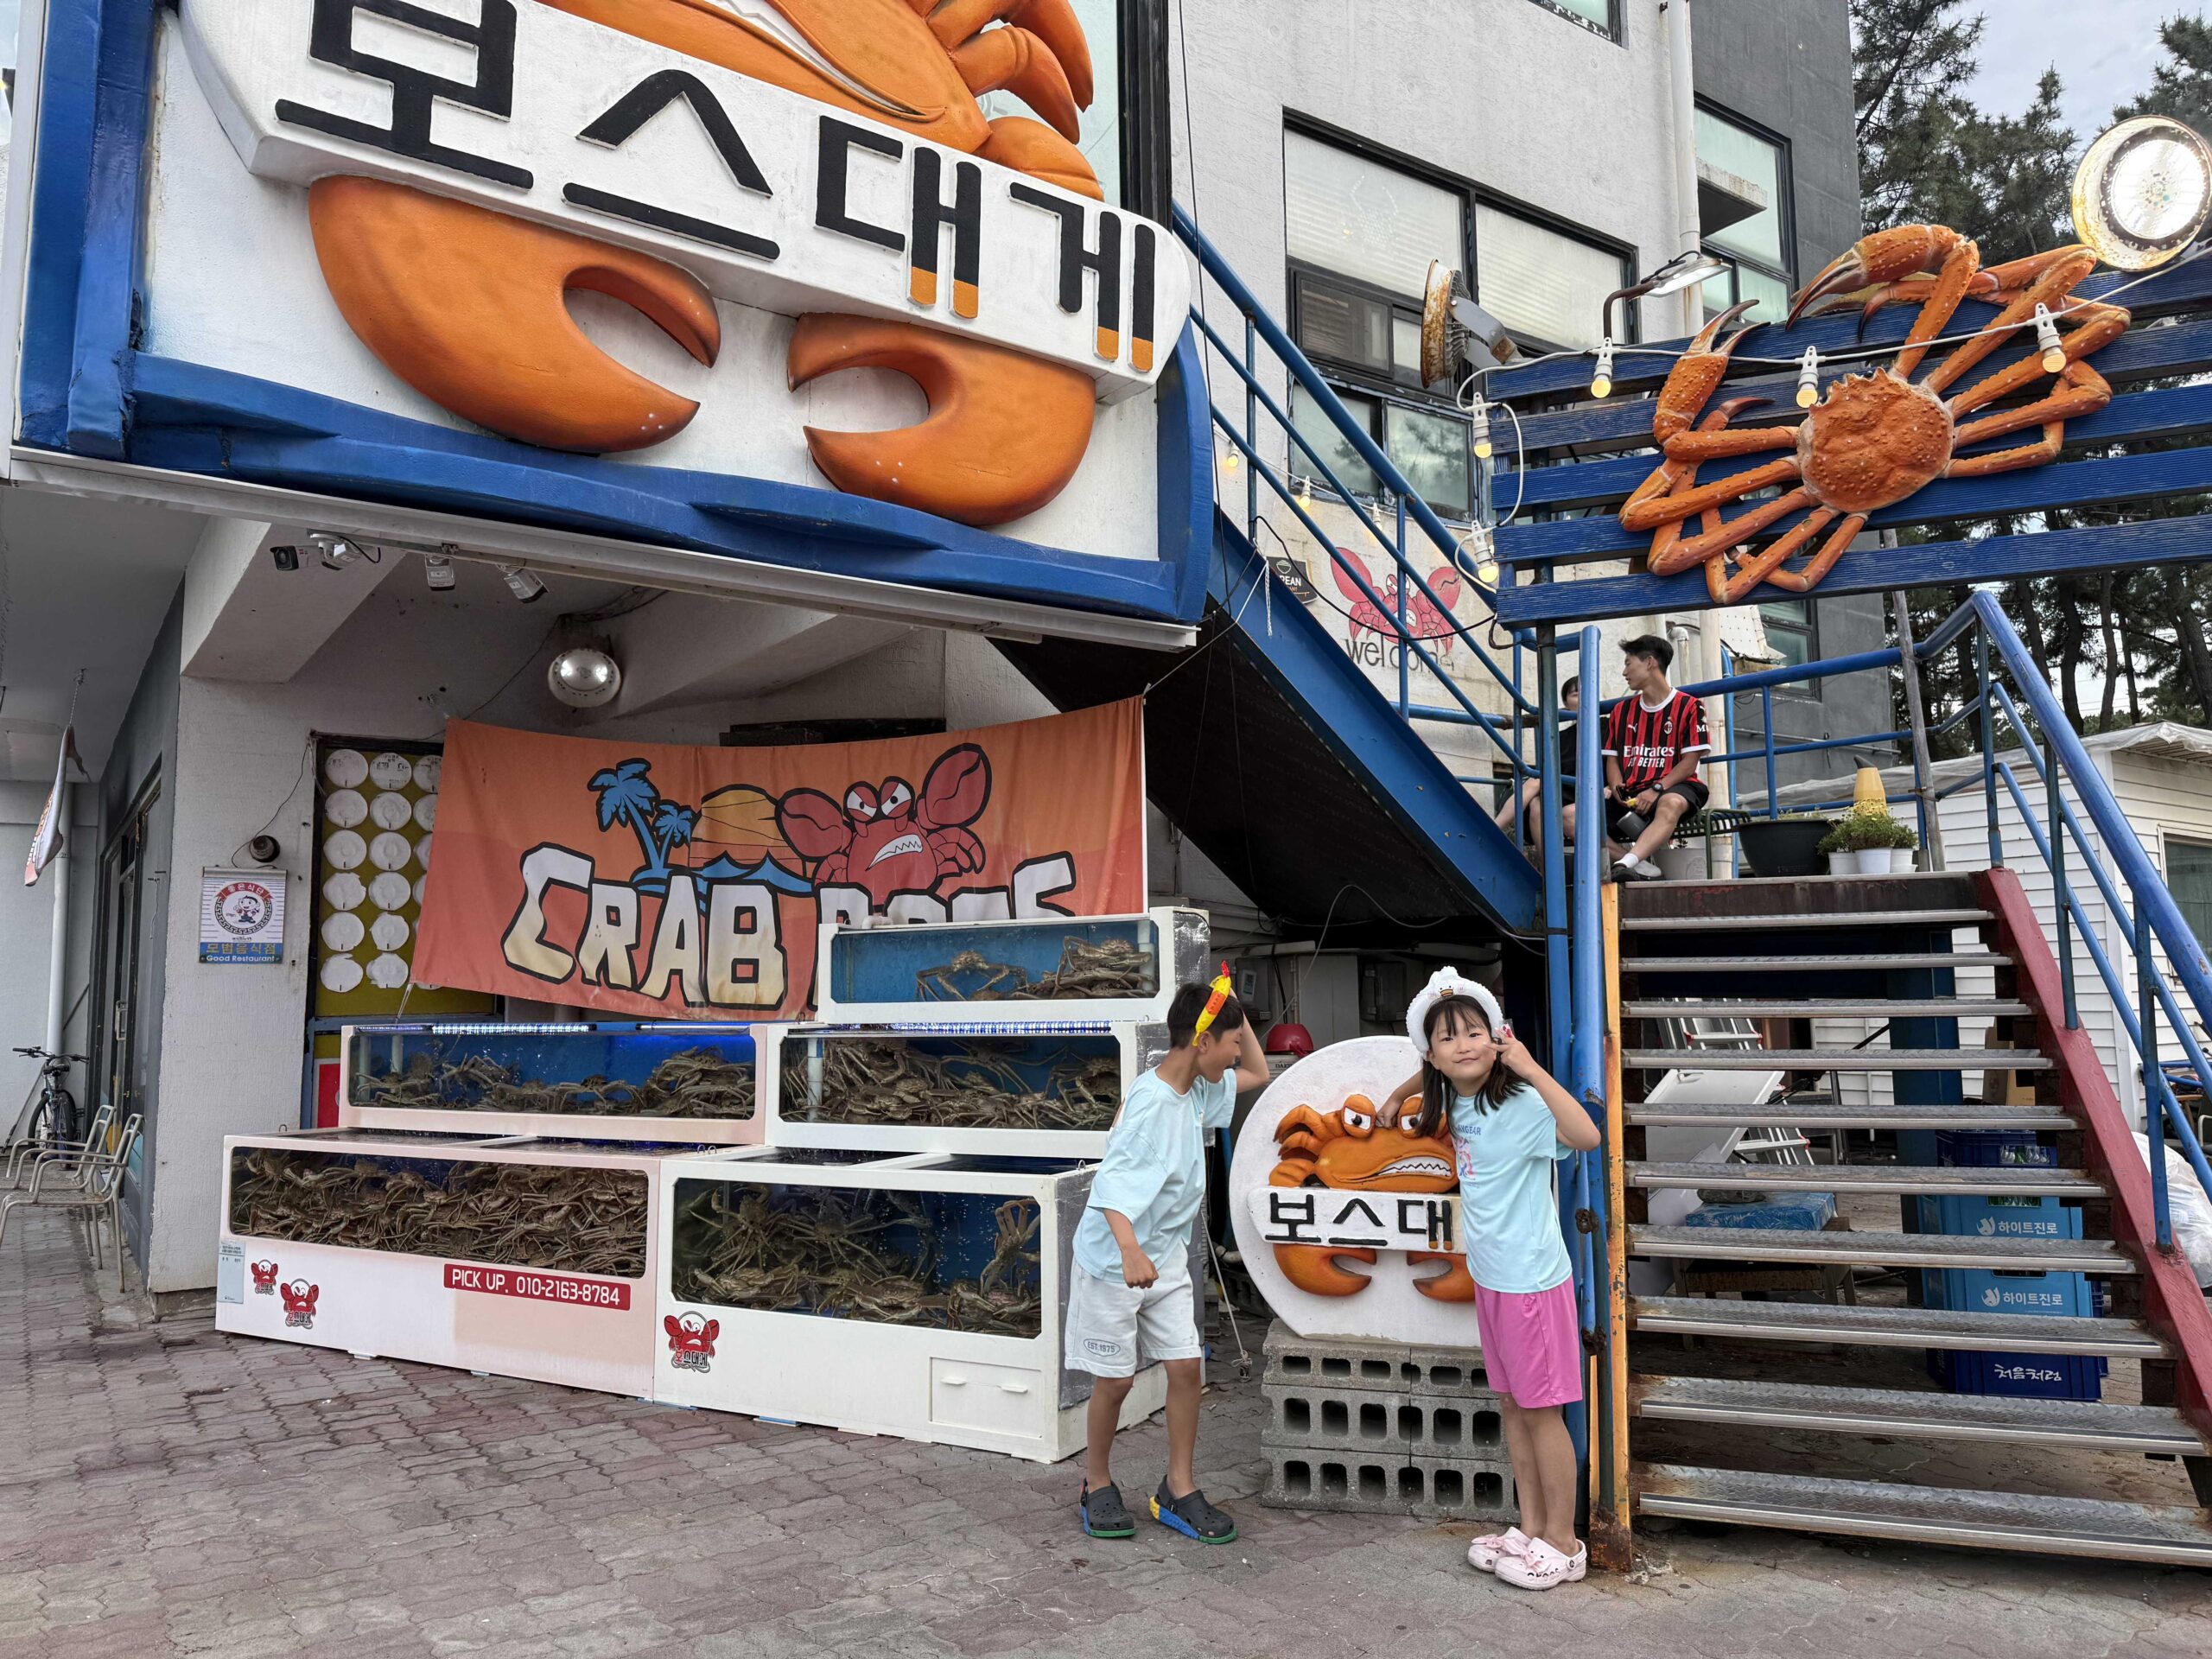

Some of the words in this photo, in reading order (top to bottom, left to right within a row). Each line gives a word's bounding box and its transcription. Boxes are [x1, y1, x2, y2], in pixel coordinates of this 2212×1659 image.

[276, 0, 1154, 373] 보스대게
[1637, 757, 1665, 767] BETTER
[501, 842, 787, 1010] CRAB
[207, 944, 276, 955] 모범음식점
[1265, 1192, 1452, 1250] 보스대
[1998, 1221, 2058, 1235] 하이트진로
[452, 1268, 481, 1289] PICK
[486, 1273, 509, 1294] UP.
[516, 1277, 620, 1306] 010-2163-8784
[2003, 1292, 2063, 1306] 하이트진로
[1994, 1364, 2063, 1382] 처음처럼
